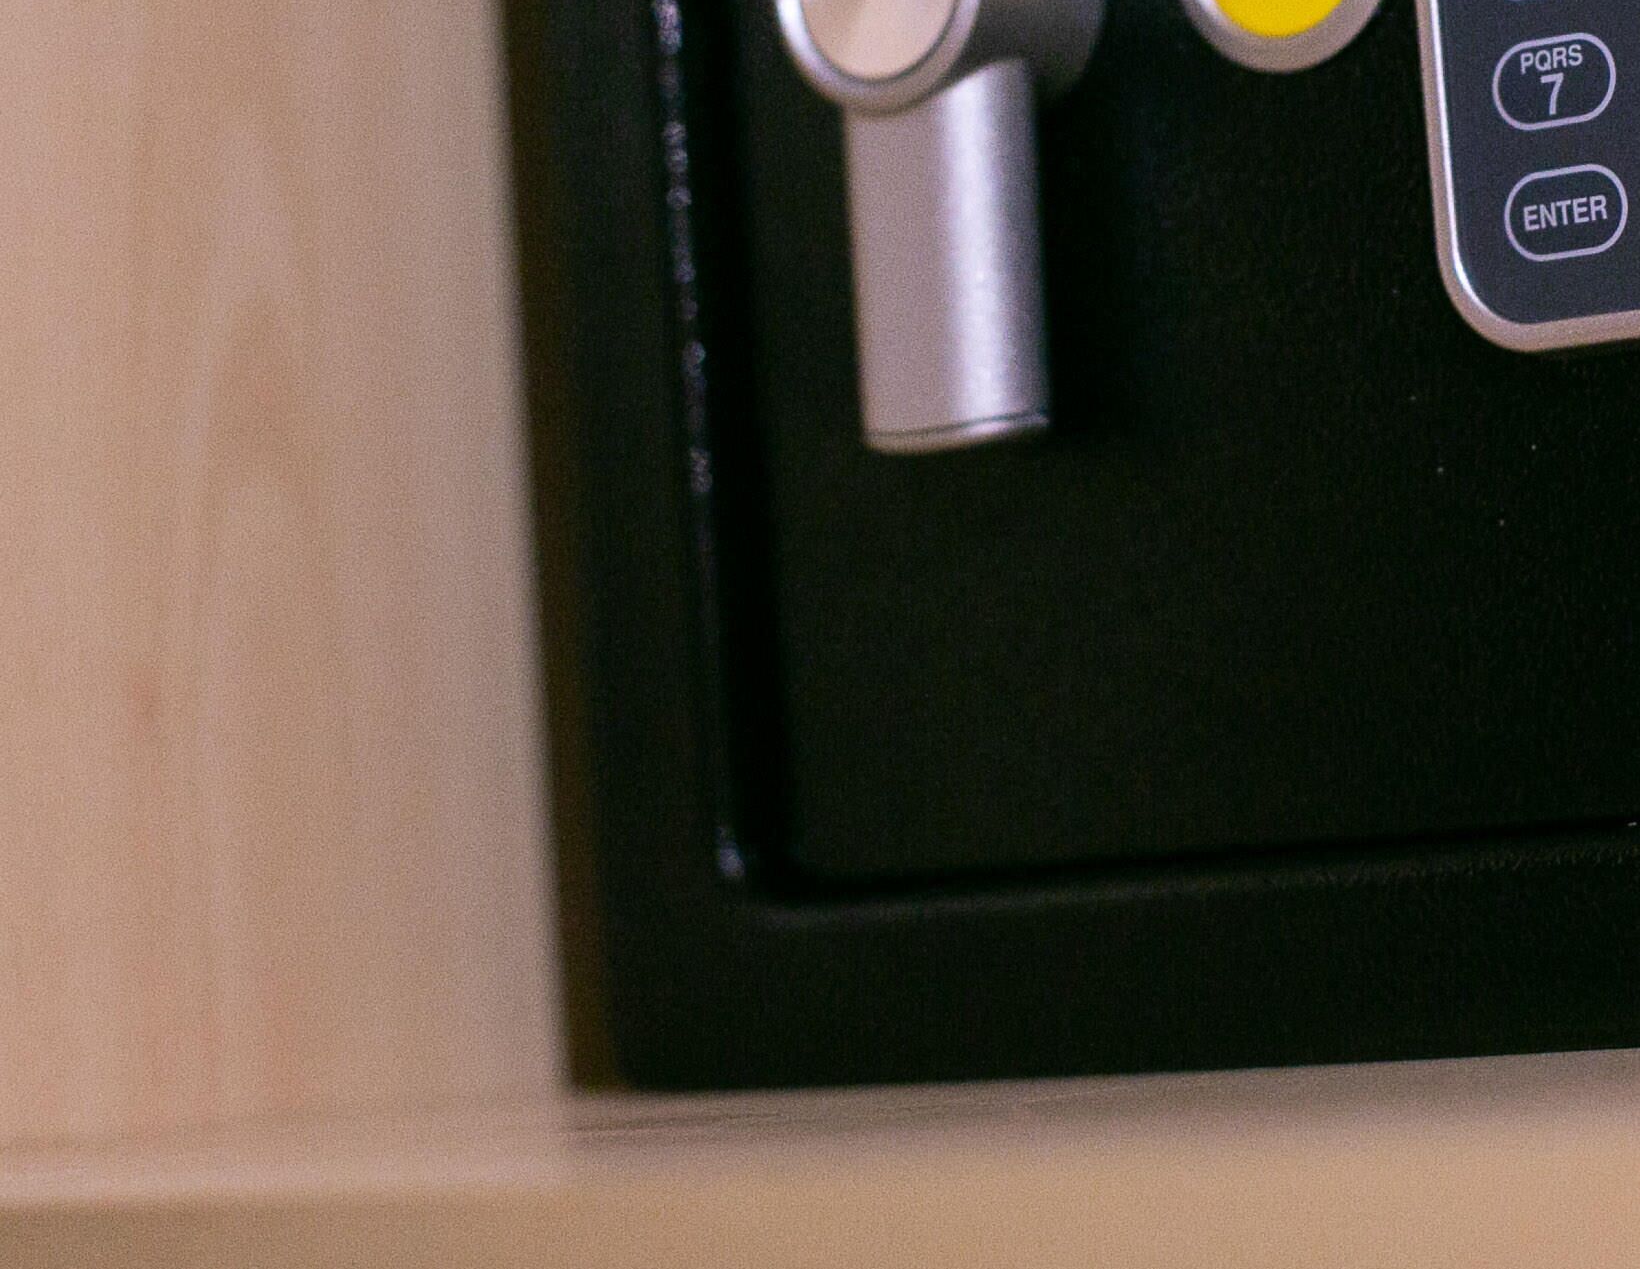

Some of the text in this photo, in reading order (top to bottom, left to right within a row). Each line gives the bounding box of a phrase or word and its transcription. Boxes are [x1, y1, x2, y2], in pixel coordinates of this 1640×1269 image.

[1519, 44, 1583, 75] PQRS
[1541, 73, 1563, 114] 7
[1524, 195, 1607, 230] ENTER
